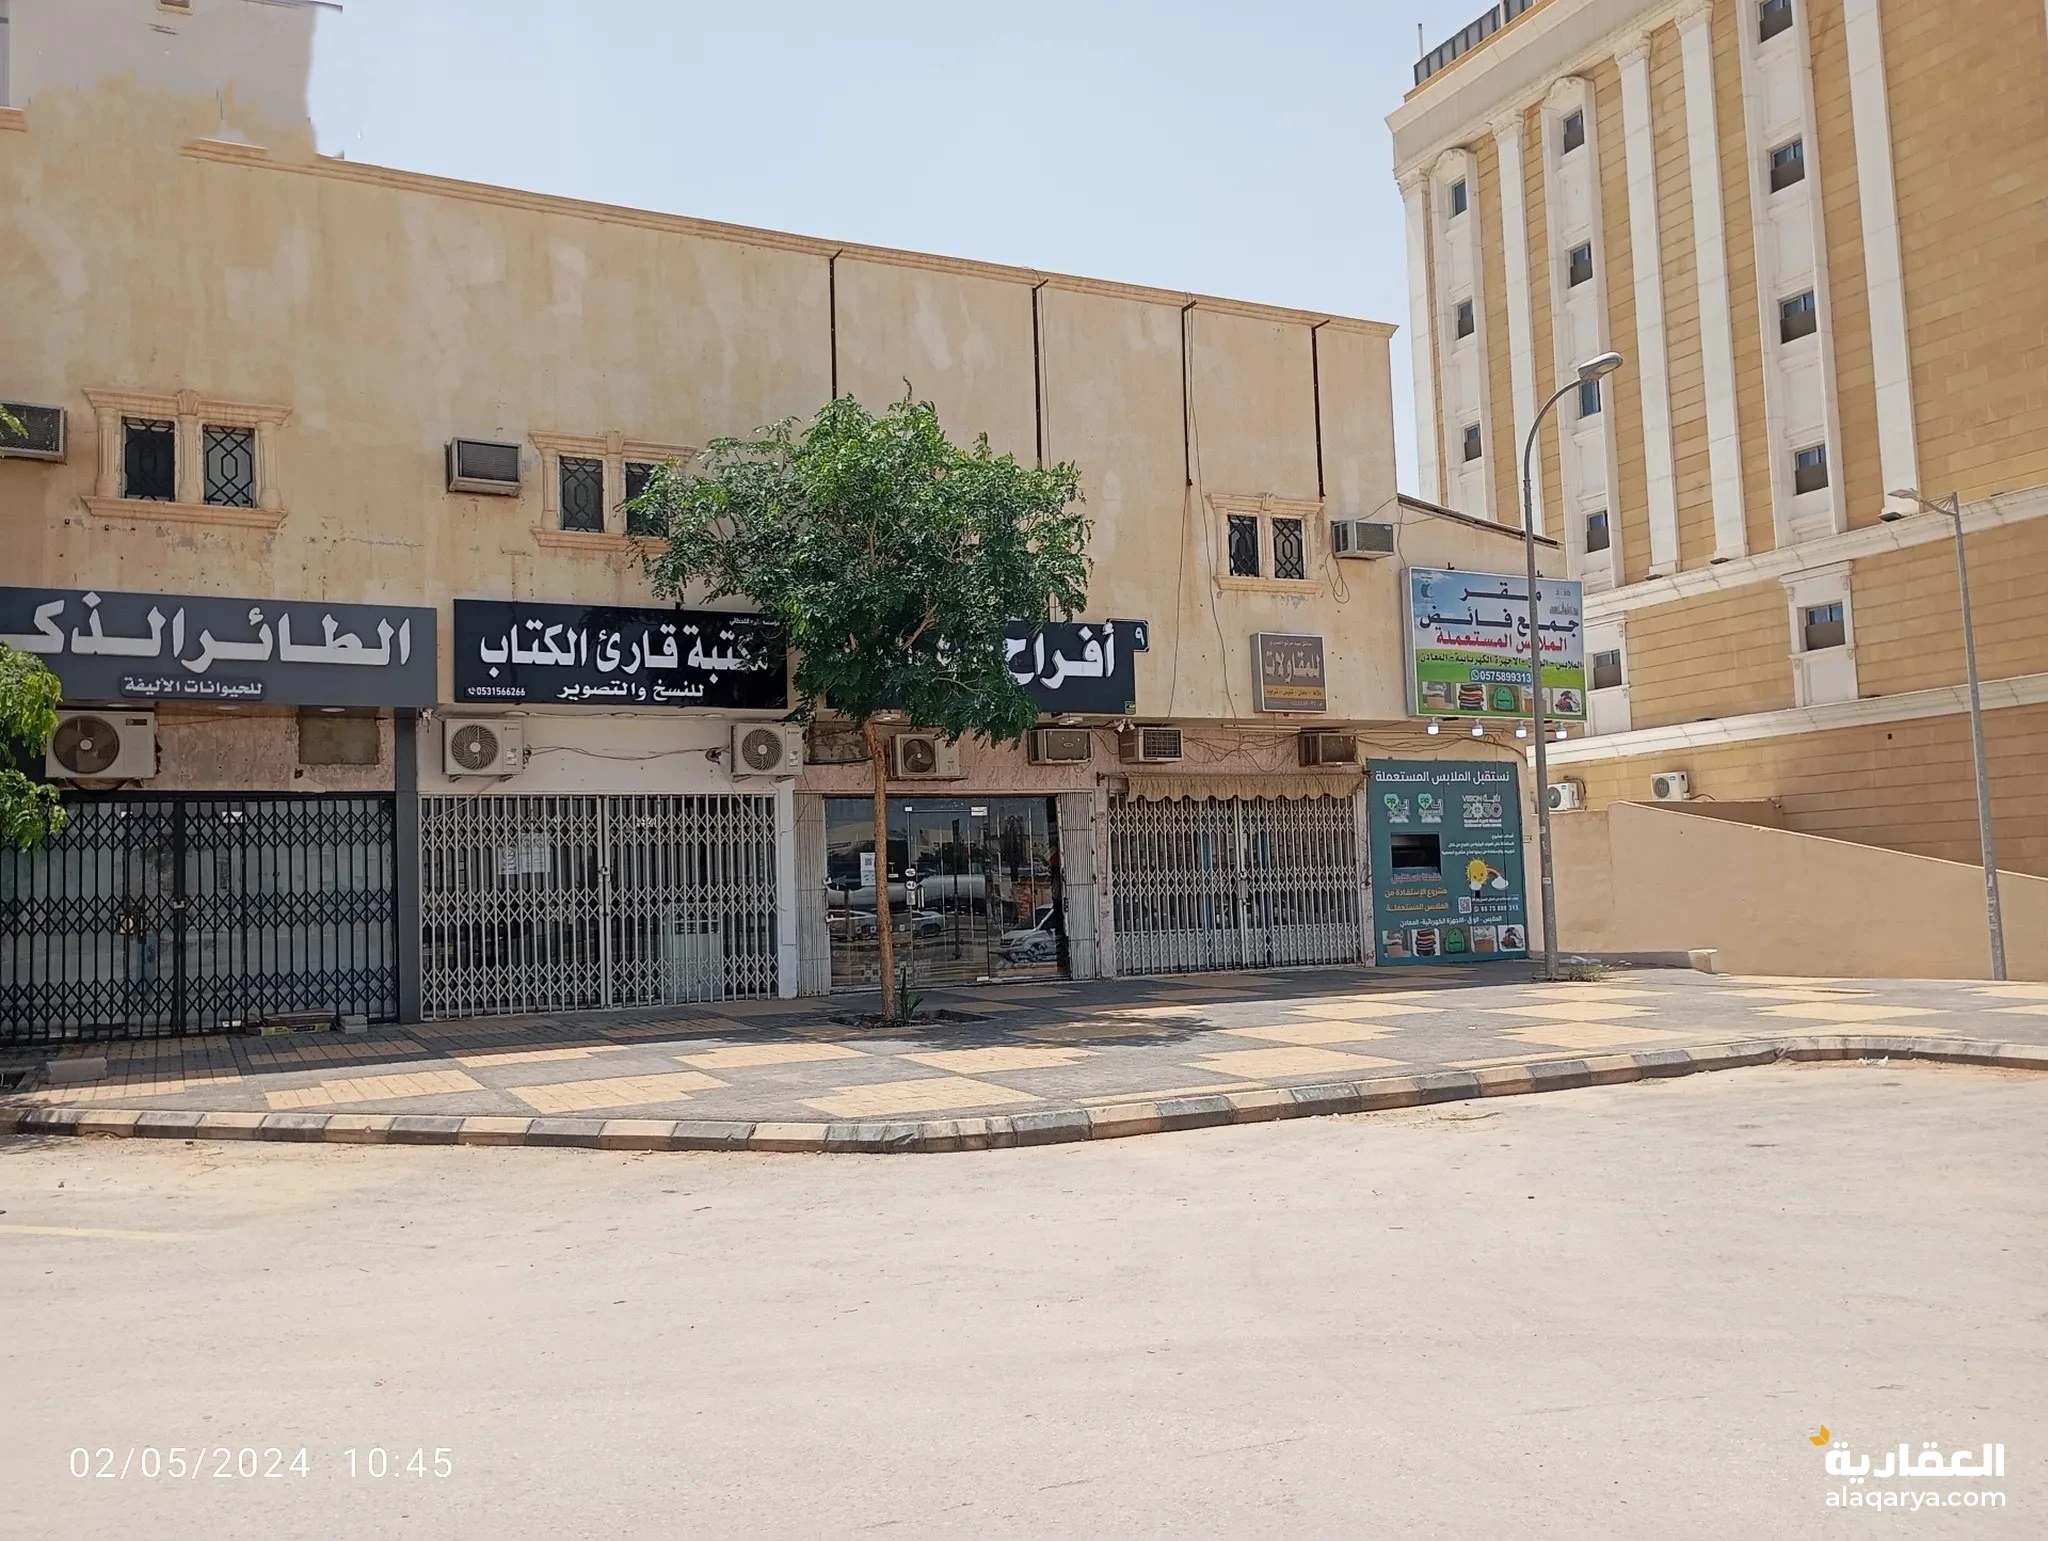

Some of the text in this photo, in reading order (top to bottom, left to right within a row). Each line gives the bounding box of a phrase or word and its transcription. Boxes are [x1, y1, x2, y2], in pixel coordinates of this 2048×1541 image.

[0, 592, 411, 673] الطائر الذك
[1420, 604, 1579, 638] جمع فائض
[480, 618, 588, 678] الكتاب
[596, 622, 679, 675] قارئ
[1436, 626, 1567, 653] الملاس المستعملة
[184, 680, 263, 697] للحيوانات
[556, 678, 704, 701] للنسخ والتصوير
[1480, 670, 1532, 684] 0575899313
[476, 686, 526, 697] 0531566266
[1375, 770, 1510, 786] نستقبل الملابس المستعملة
